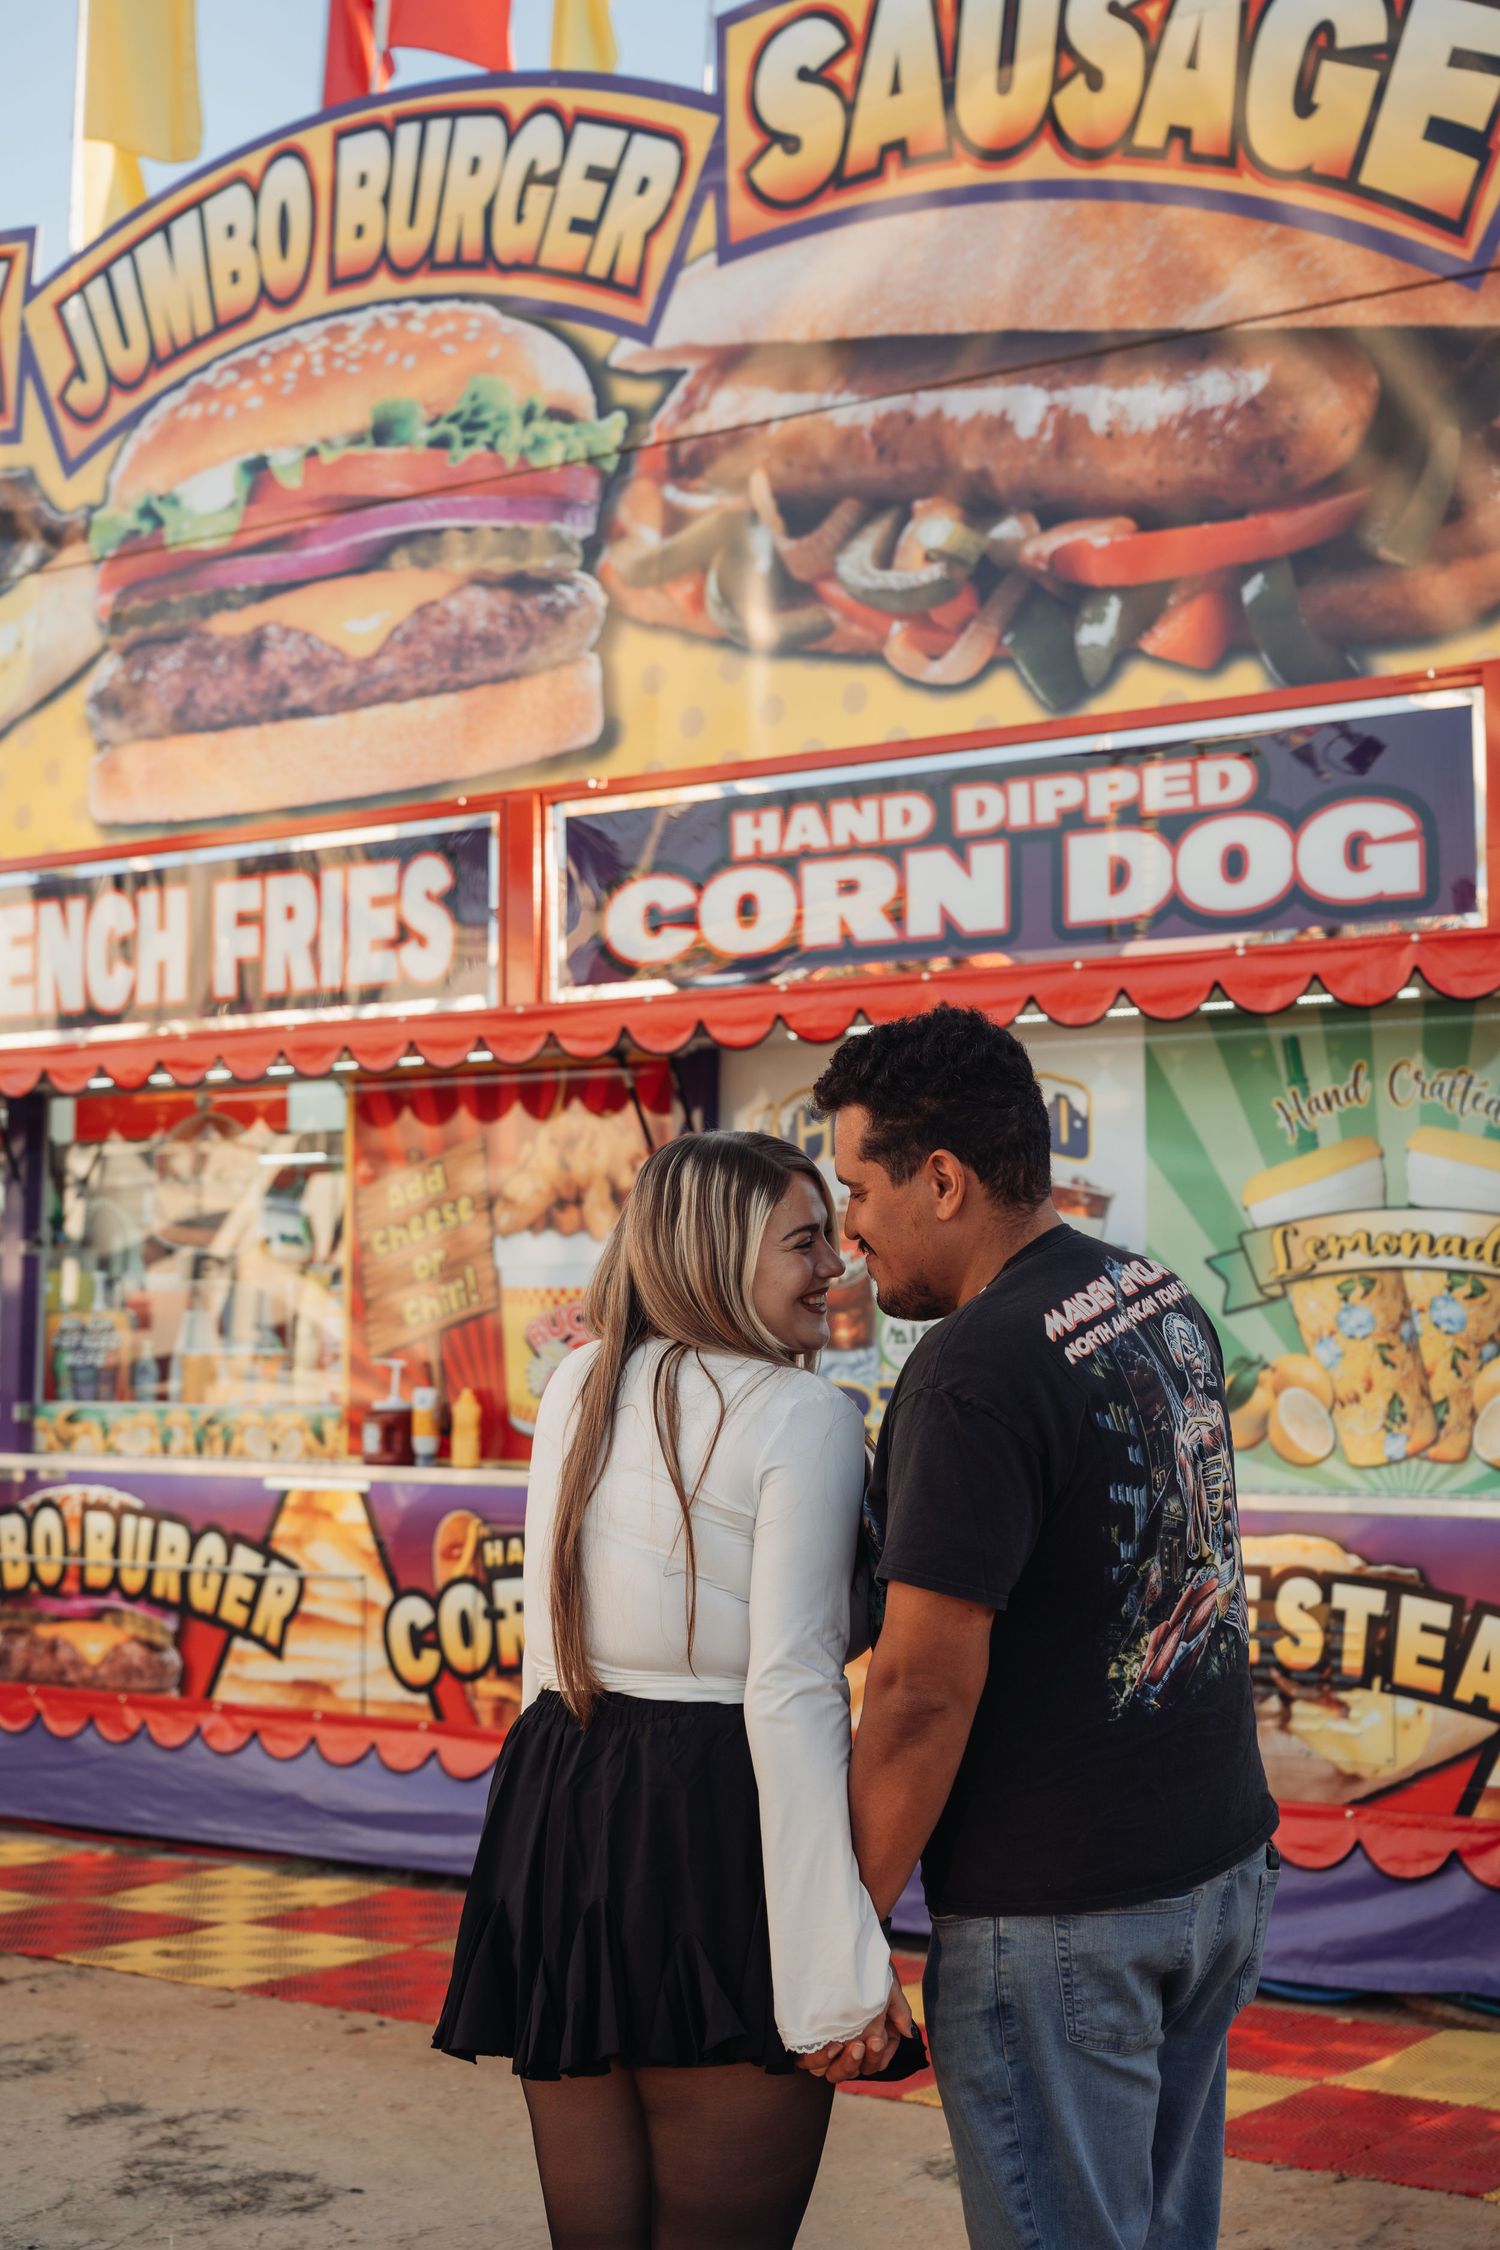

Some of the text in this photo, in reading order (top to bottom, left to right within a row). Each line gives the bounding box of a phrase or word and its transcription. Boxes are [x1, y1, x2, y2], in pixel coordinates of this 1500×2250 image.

[746, 0, 1500, 226] SAUSAGE
[60, 112, 684, 419] JUMBO BURGER
[731, 755, 1256, 859] HAND DIPPED
[211, 853, 455, 998] FRIES
[605, 799, 1426, 966] CORN DOG
[1273, 1060, 1369, 1144] Hand
[1043, 1275, 1118, 1343] MAIDEN
[1064, 1322, 1116, 1366] NORTH
[1154, 1282, 1183, 1308] TOUR
[81, 1507, 301, 1649] BURGER
